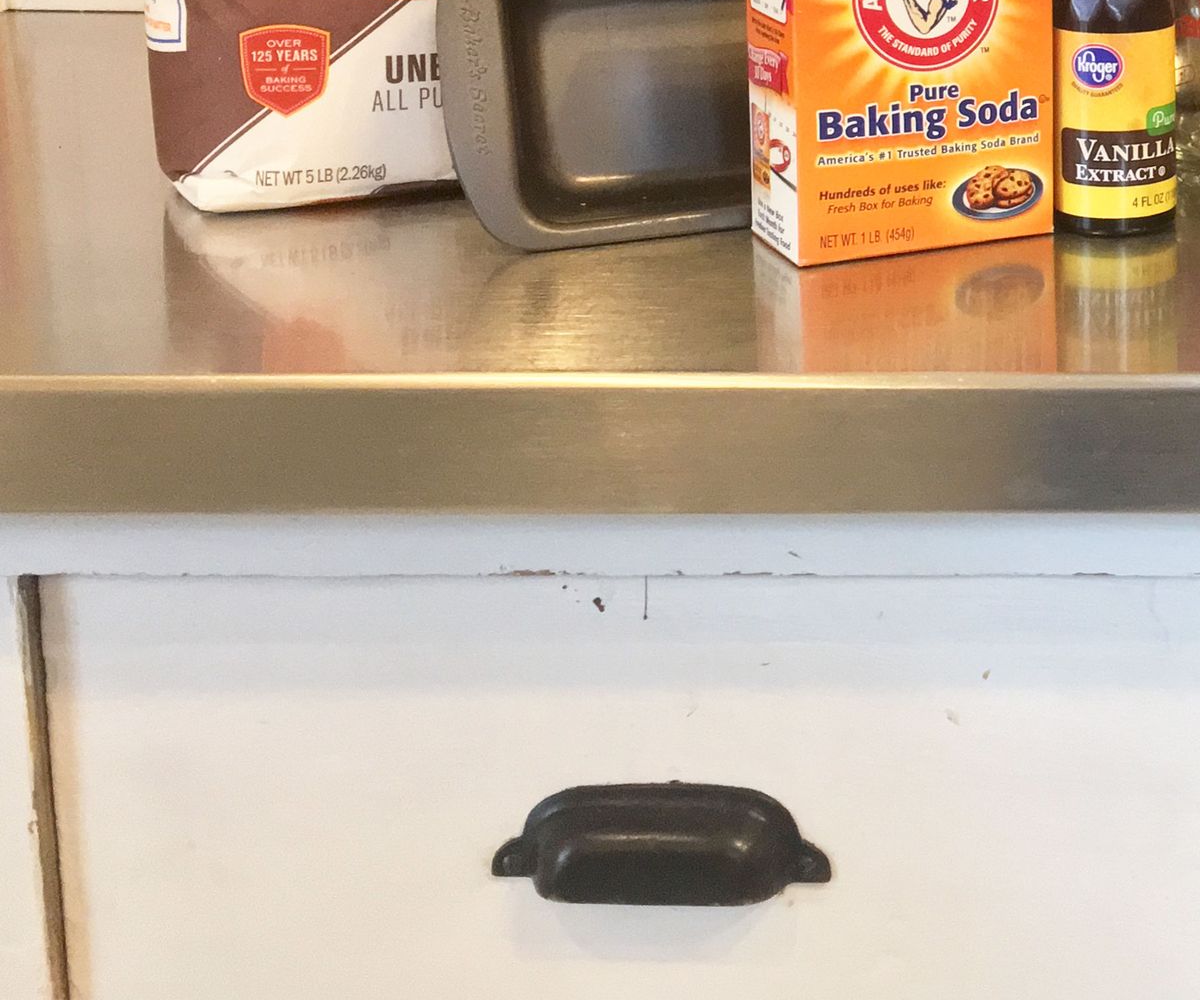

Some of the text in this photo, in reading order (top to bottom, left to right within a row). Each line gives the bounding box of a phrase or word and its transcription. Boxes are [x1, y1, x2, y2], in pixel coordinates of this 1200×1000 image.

[266, 39, 302, 48] OVER
[877, 18, 978, 57] THE STANDARD OF PURITY
[251, 49, 318, 63] 125 YEARS
[1077, 51, 1119, 83] Kroger
[260, 84, 313, 93] SUCCESS
[265, 76, 306, 85] BAKING
[372, 89, 408, 112] ALL
[909, 84, 960, 102] Pure
[817, 89, 1038, 140] Baking Soda
[817, 133, 1039, 166] America's #1 Trusted Baking Soda Brand
[1076, 137, 1175, 162] VANILLA
[255, 163, 387, 187] NET WT 5 LB (2.26kg)
[1075, 164, 1157, 182] EXTRACT
[819, 178, 947, 201] Hundreds of uses like:
[1132, 197, 1138, 208] 4
[1141, 195, 1152, 207] FL
[1154, 192, 1165, 204] OZ
[827, 195, 934, 215] Fresh Box for Baking
[819, 234, 838, 250] NET
[861, 232, 866, 244] 1
[886, 226, 916, 244] (454g)
